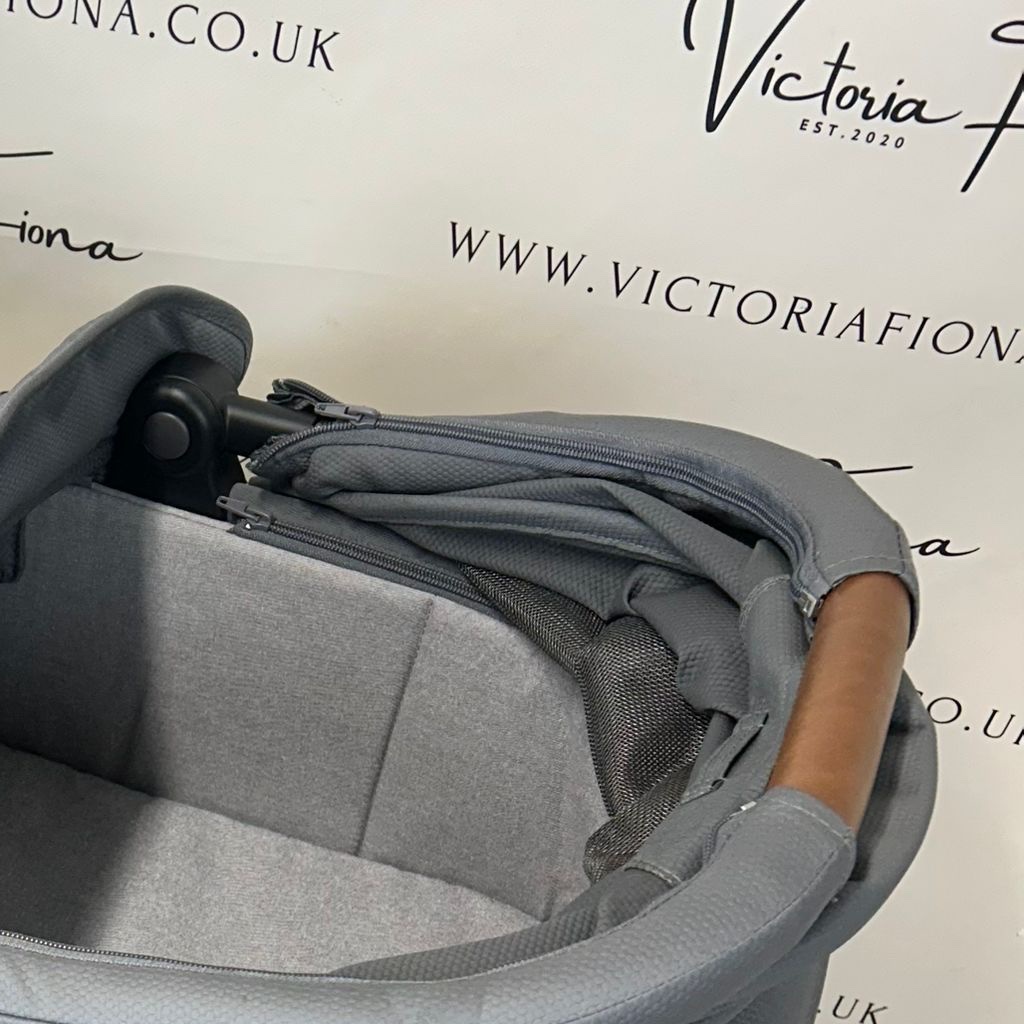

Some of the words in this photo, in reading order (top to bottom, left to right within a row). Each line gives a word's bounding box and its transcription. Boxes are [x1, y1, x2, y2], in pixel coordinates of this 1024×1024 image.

[684, 0, 963, 133] Victoria
[799, 118, 907, 149] EST.2020
[449, 220, 1024, 364] WWW.VICTORIAFION
